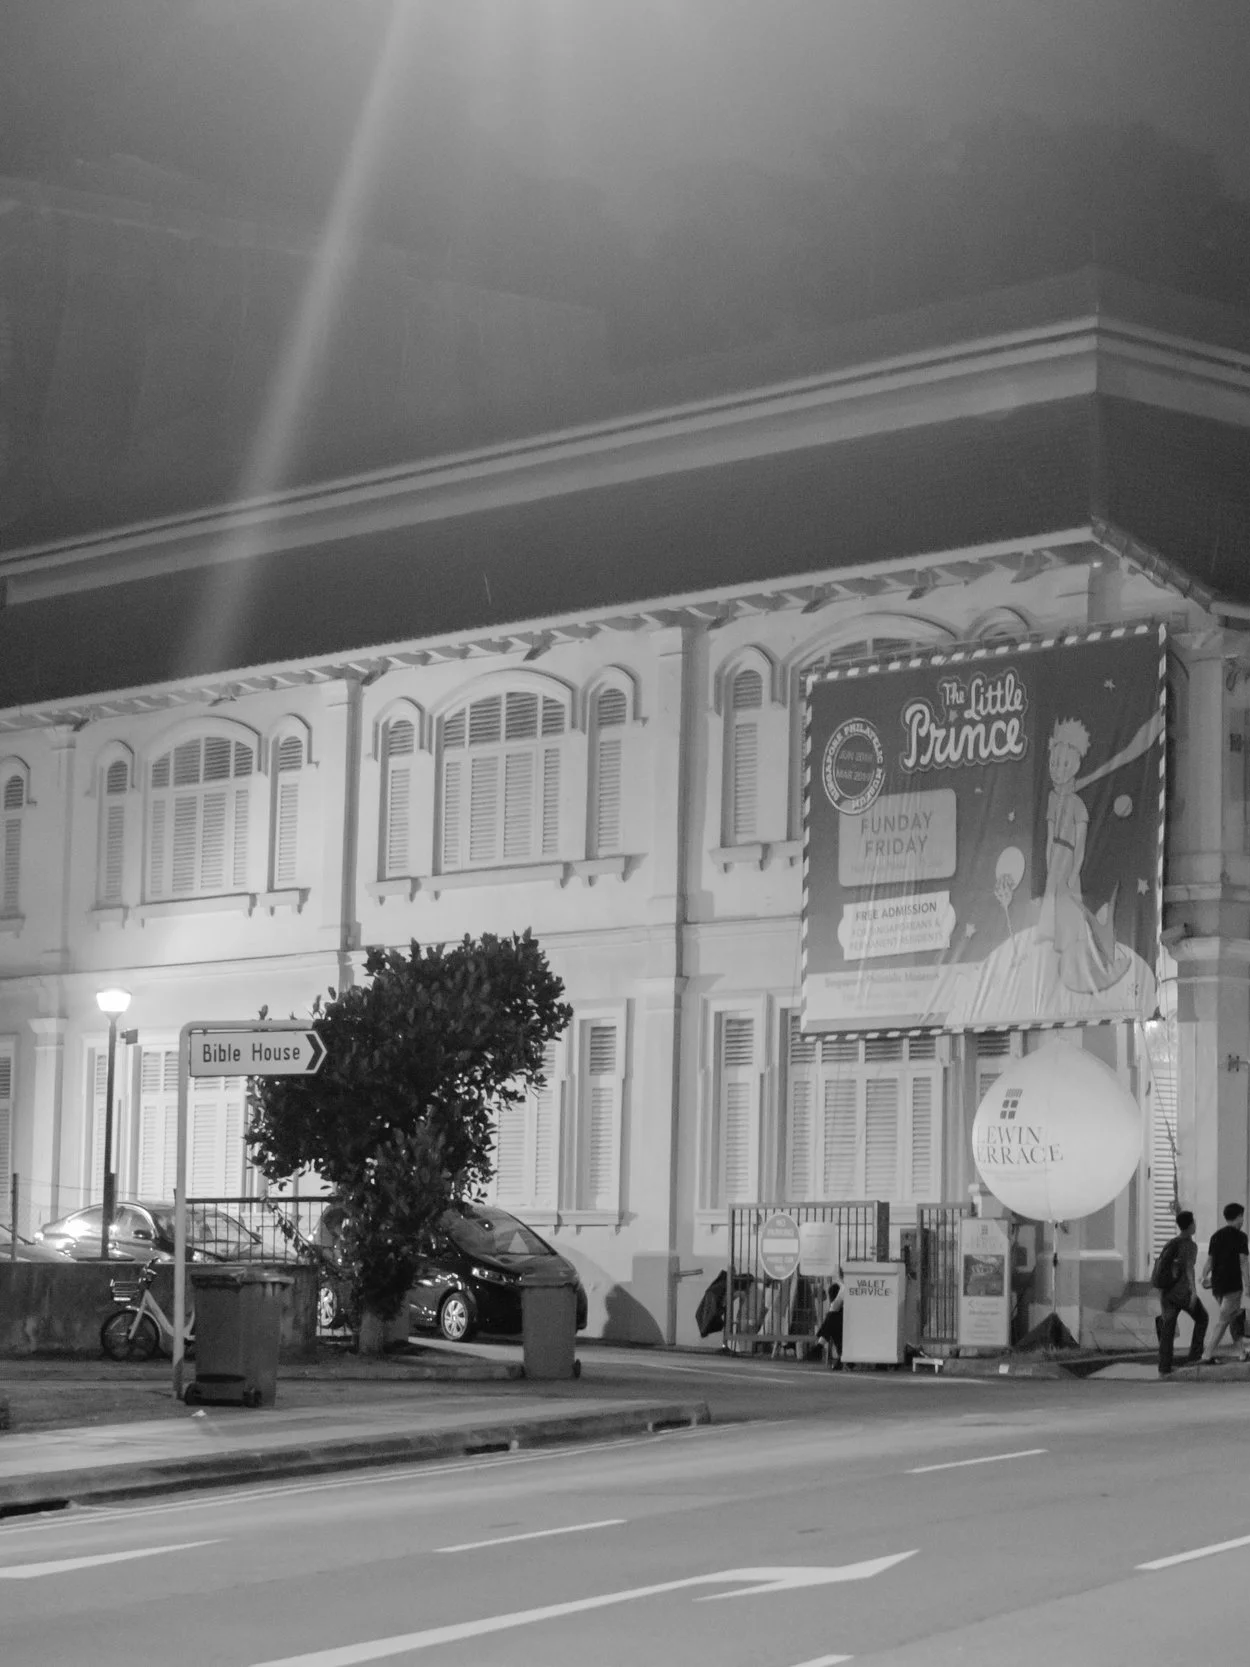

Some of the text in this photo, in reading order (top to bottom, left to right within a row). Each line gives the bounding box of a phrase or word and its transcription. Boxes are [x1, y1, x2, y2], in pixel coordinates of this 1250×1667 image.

[942, 673, 1023, 720] The Little
[904, 703, 1023, 767] Prince
[861, 811, 932, 834] FUNDAY
[865, 835, 928, 857] FRIDAY
[856, 902, 937, 921] FREE ADMISSION
[202, 1042, 300, 1063] Bible House
[977, 1125, 1043, 1145] LEWIN
[976, 1143, 1064, 1164] ERRACE
[849, 1287, 891, 1296] SERVICE
[856, 1279, 886, 1288] VALET
